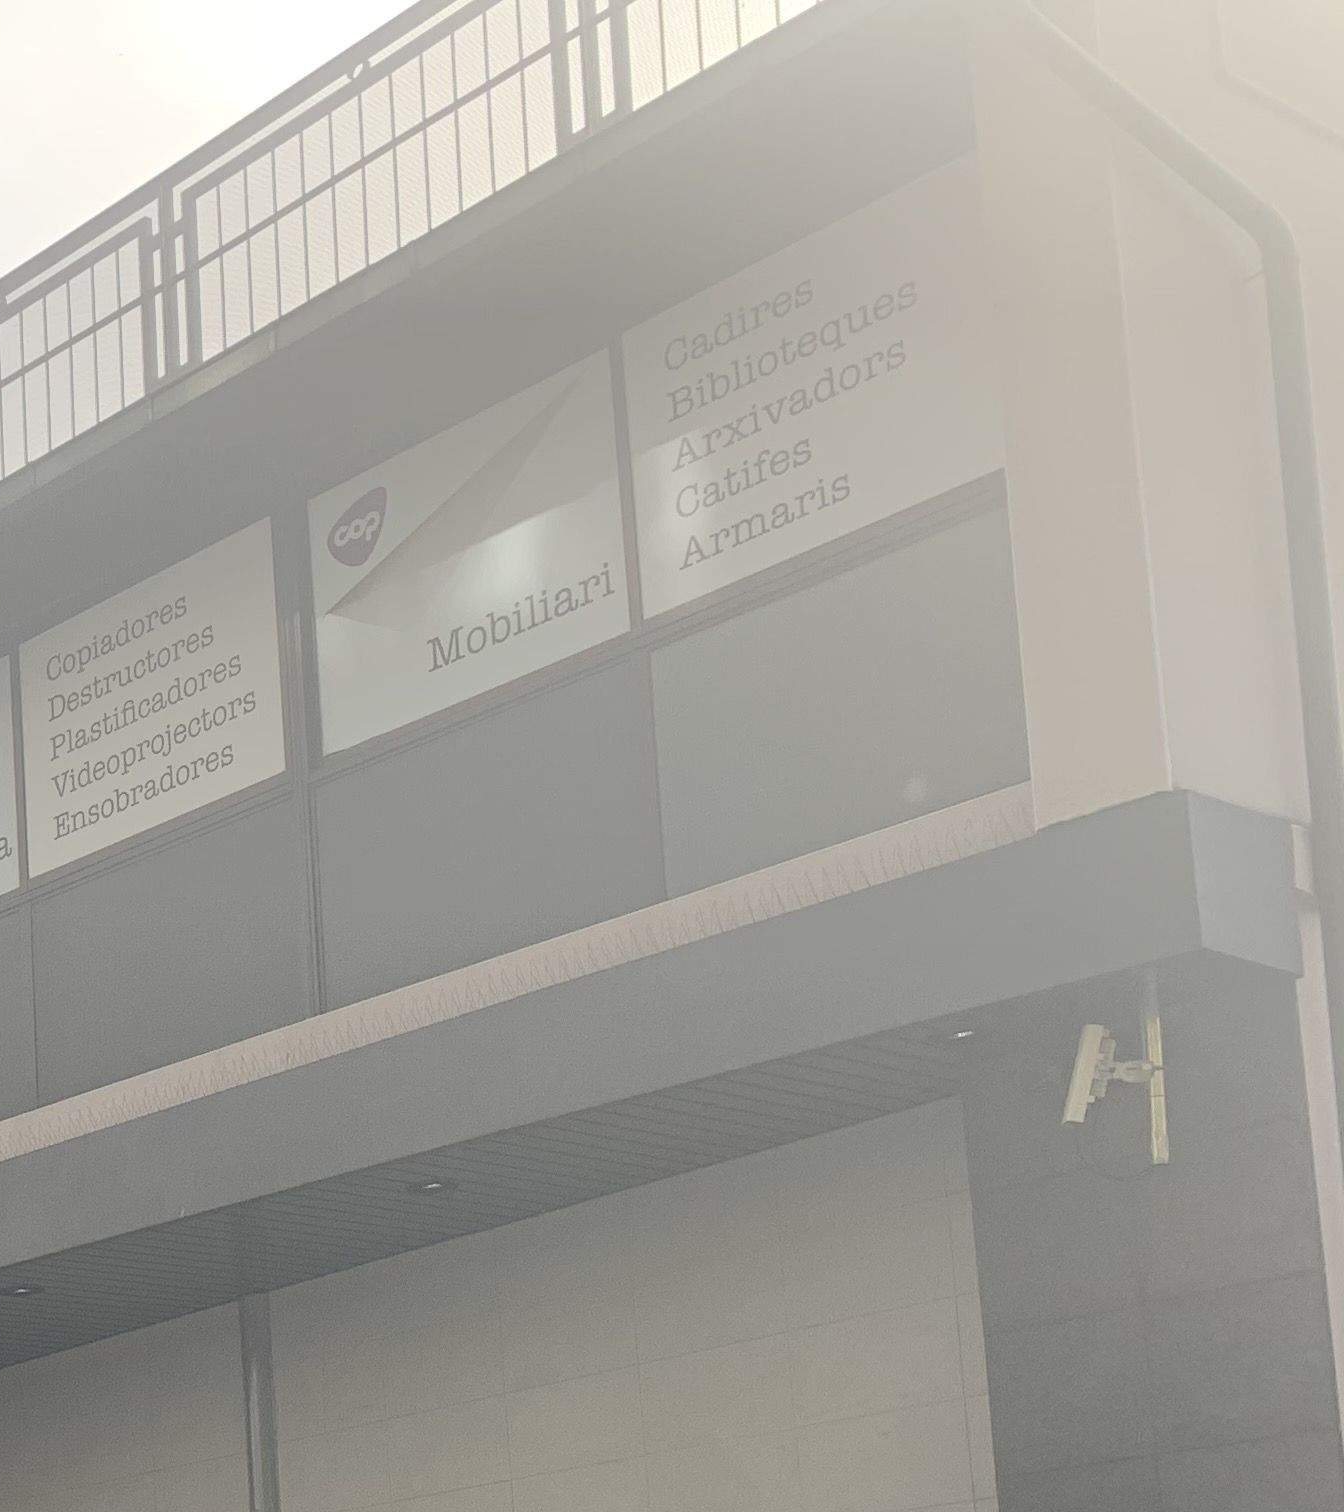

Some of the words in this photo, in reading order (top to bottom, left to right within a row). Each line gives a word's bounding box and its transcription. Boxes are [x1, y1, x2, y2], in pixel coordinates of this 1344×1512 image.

[664, 278, 814, 371] Cadires
[667, 280, 918, 423] Biblioteques
[672, 339, 906, 472] Arxivadors
[676, 438, 812, 518] Catifes
[680, 473, 850, 570] Armaris
[334, 511, 381, 546] cop
[46, 596, 187, 681] Copiadores
[427, 562, 615, 673] Mobiliari
[48, 624, 214, 722] Destructores
[49, 654, 241, 761] Plastificadores
[51, 690, 256, 798] Videoprojectors
[53, 744, 234, 840] Ensobradores
